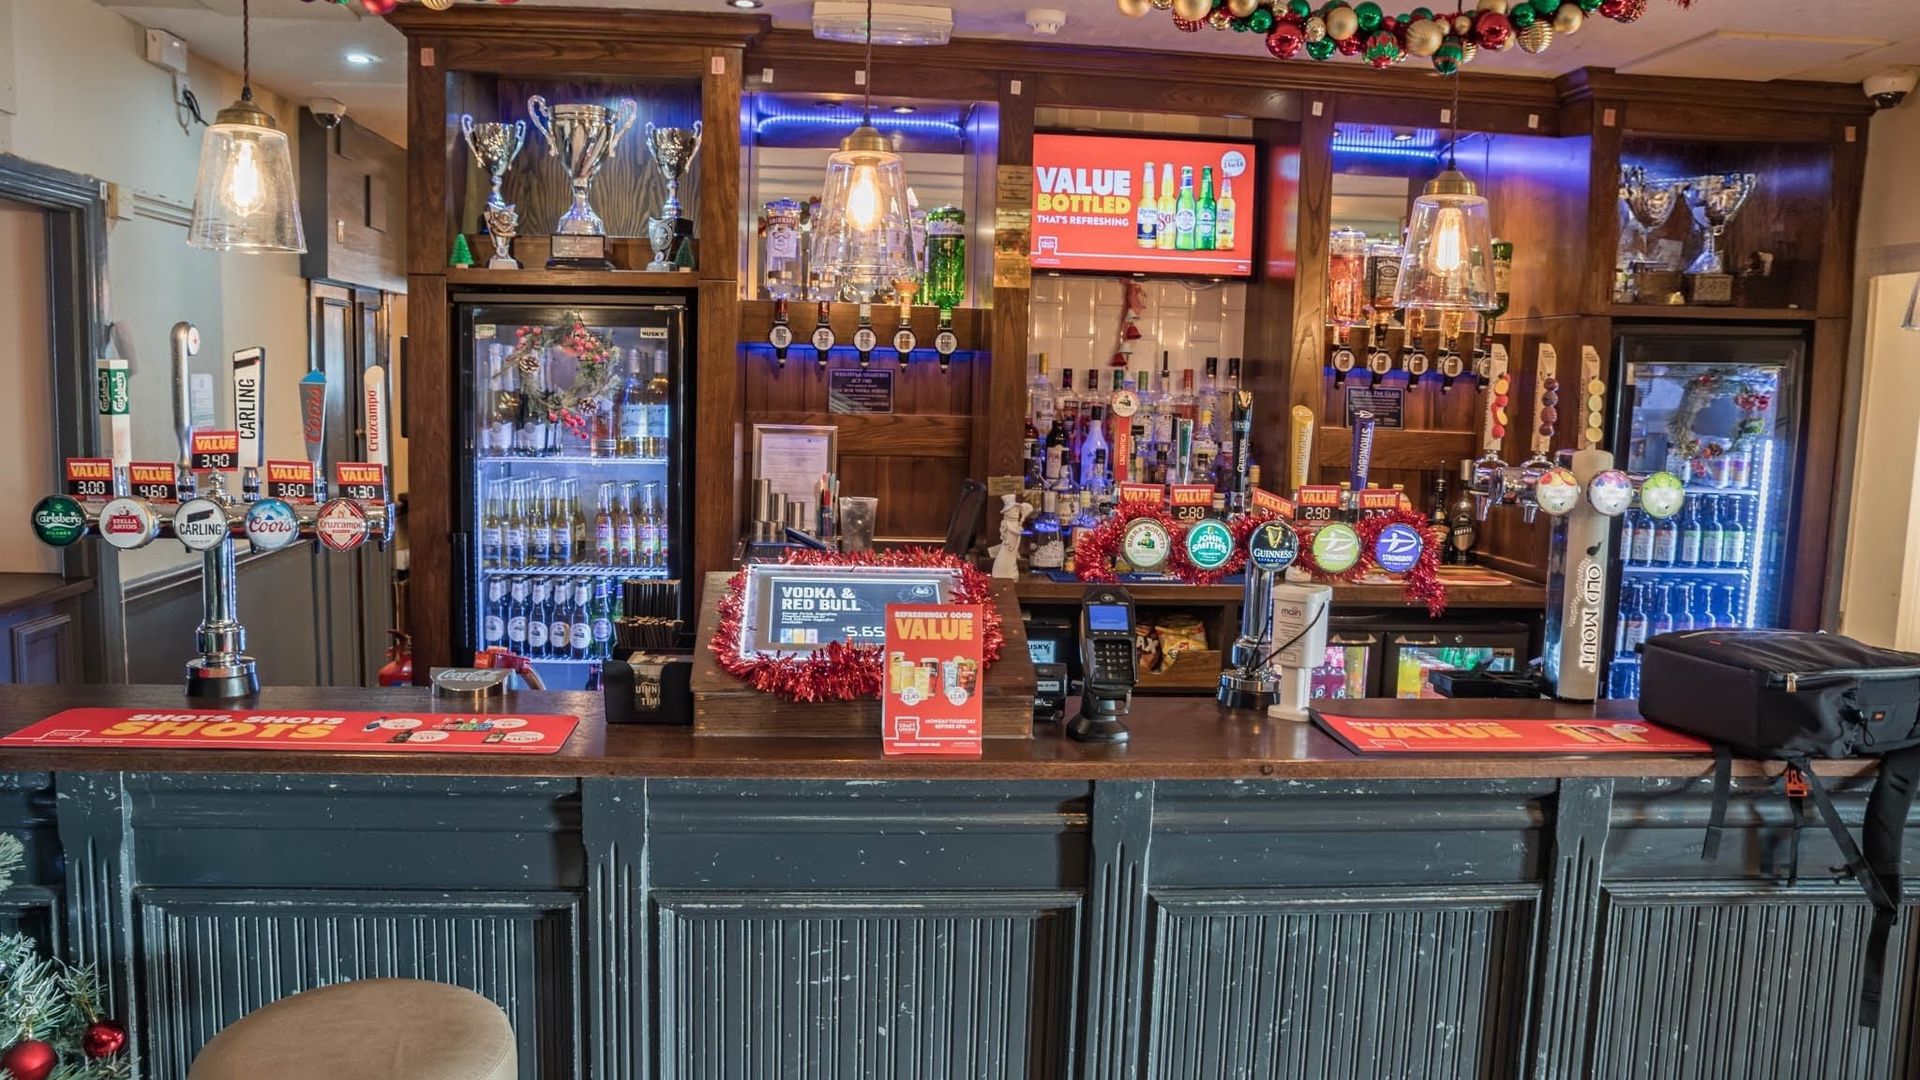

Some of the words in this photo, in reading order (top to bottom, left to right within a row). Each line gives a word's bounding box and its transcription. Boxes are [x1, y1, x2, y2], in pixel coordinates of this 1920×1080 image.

[1036, 167, 1131, 196] VALUE
[1037, 193, 1131, 214] BOTTLED
[1037, 215, 1068, 224] THAT'S
[1069, 216, 1129, 226] REFRESHING
[100, 371, 110, 412] Carlsberg
[112, 371, 128, 412] Carlsberg
[239, 378, 256, 440] CARLING
[304, 386, 322, 444] Coors
[368, 390, 380, 452] Cruzcampo
[195, 439, 236, 450] VALUE
[1237, 439, 1246, 472] GUINNESS
[1357, 428, 1370, 478] STRONGBOW
[201, 454, 230, 467] 3.40
[71, 466, 110, 477] VALUE
[132, 470, 173, 481] VALUE
[271, 469, 311, 480] VALUE
[339, 470, 380, 482] VALUE
[78, 481, 105, 494] 3.00
[140, 484, 168, 498] 4.60
[277, 483, 305, 497] 3.60
[348, 485, 375, 499] 4.30
[1174, 491, 1210, 503] VALUE
[1302, 492, 1337, 503] VALUE
[1363, 496, 1396, 507] VALUE
[1257, 494, 1292, 514] VALUE
[36, 511, 82, 525] Carlsberg
[1179, 506, 1204, 519] 2.80
[1305, 507, 1330, 519] 2.90
[179, 523, 222, 535] CARLING
[250, 517, 291, 533] Coors
[319, 520, 362, 530] Cruzcampo
[1127, 527, 1143, 548] BIRRA
[1144, 526, 1165, 549] MORETTI
[1199, 534, 1223, 543] JOHN
[1191, 541, 1227, 553] SMITH'S
[1253, 547, 1293, 558] GUINNESS
[1587, 565, 1600, 604] OLD
[782, 586, 837, 598] VODKA
[840, 587, 856, 599] &
[782, 599, 816, 610] RED
[819, 599, 861, 611] BULL
[1281, 608, 1301, 616] main
[895, 618, 974, 640] VALUE
[1582, 611, 1598, 667] MOUT
[128, 713, 233, 723] SHOTS,
[243, 715, 346, 724] SHOTS
[100, 721, 337, 738] SHOTS
[1351, 725, 1524, 738] VALUE
